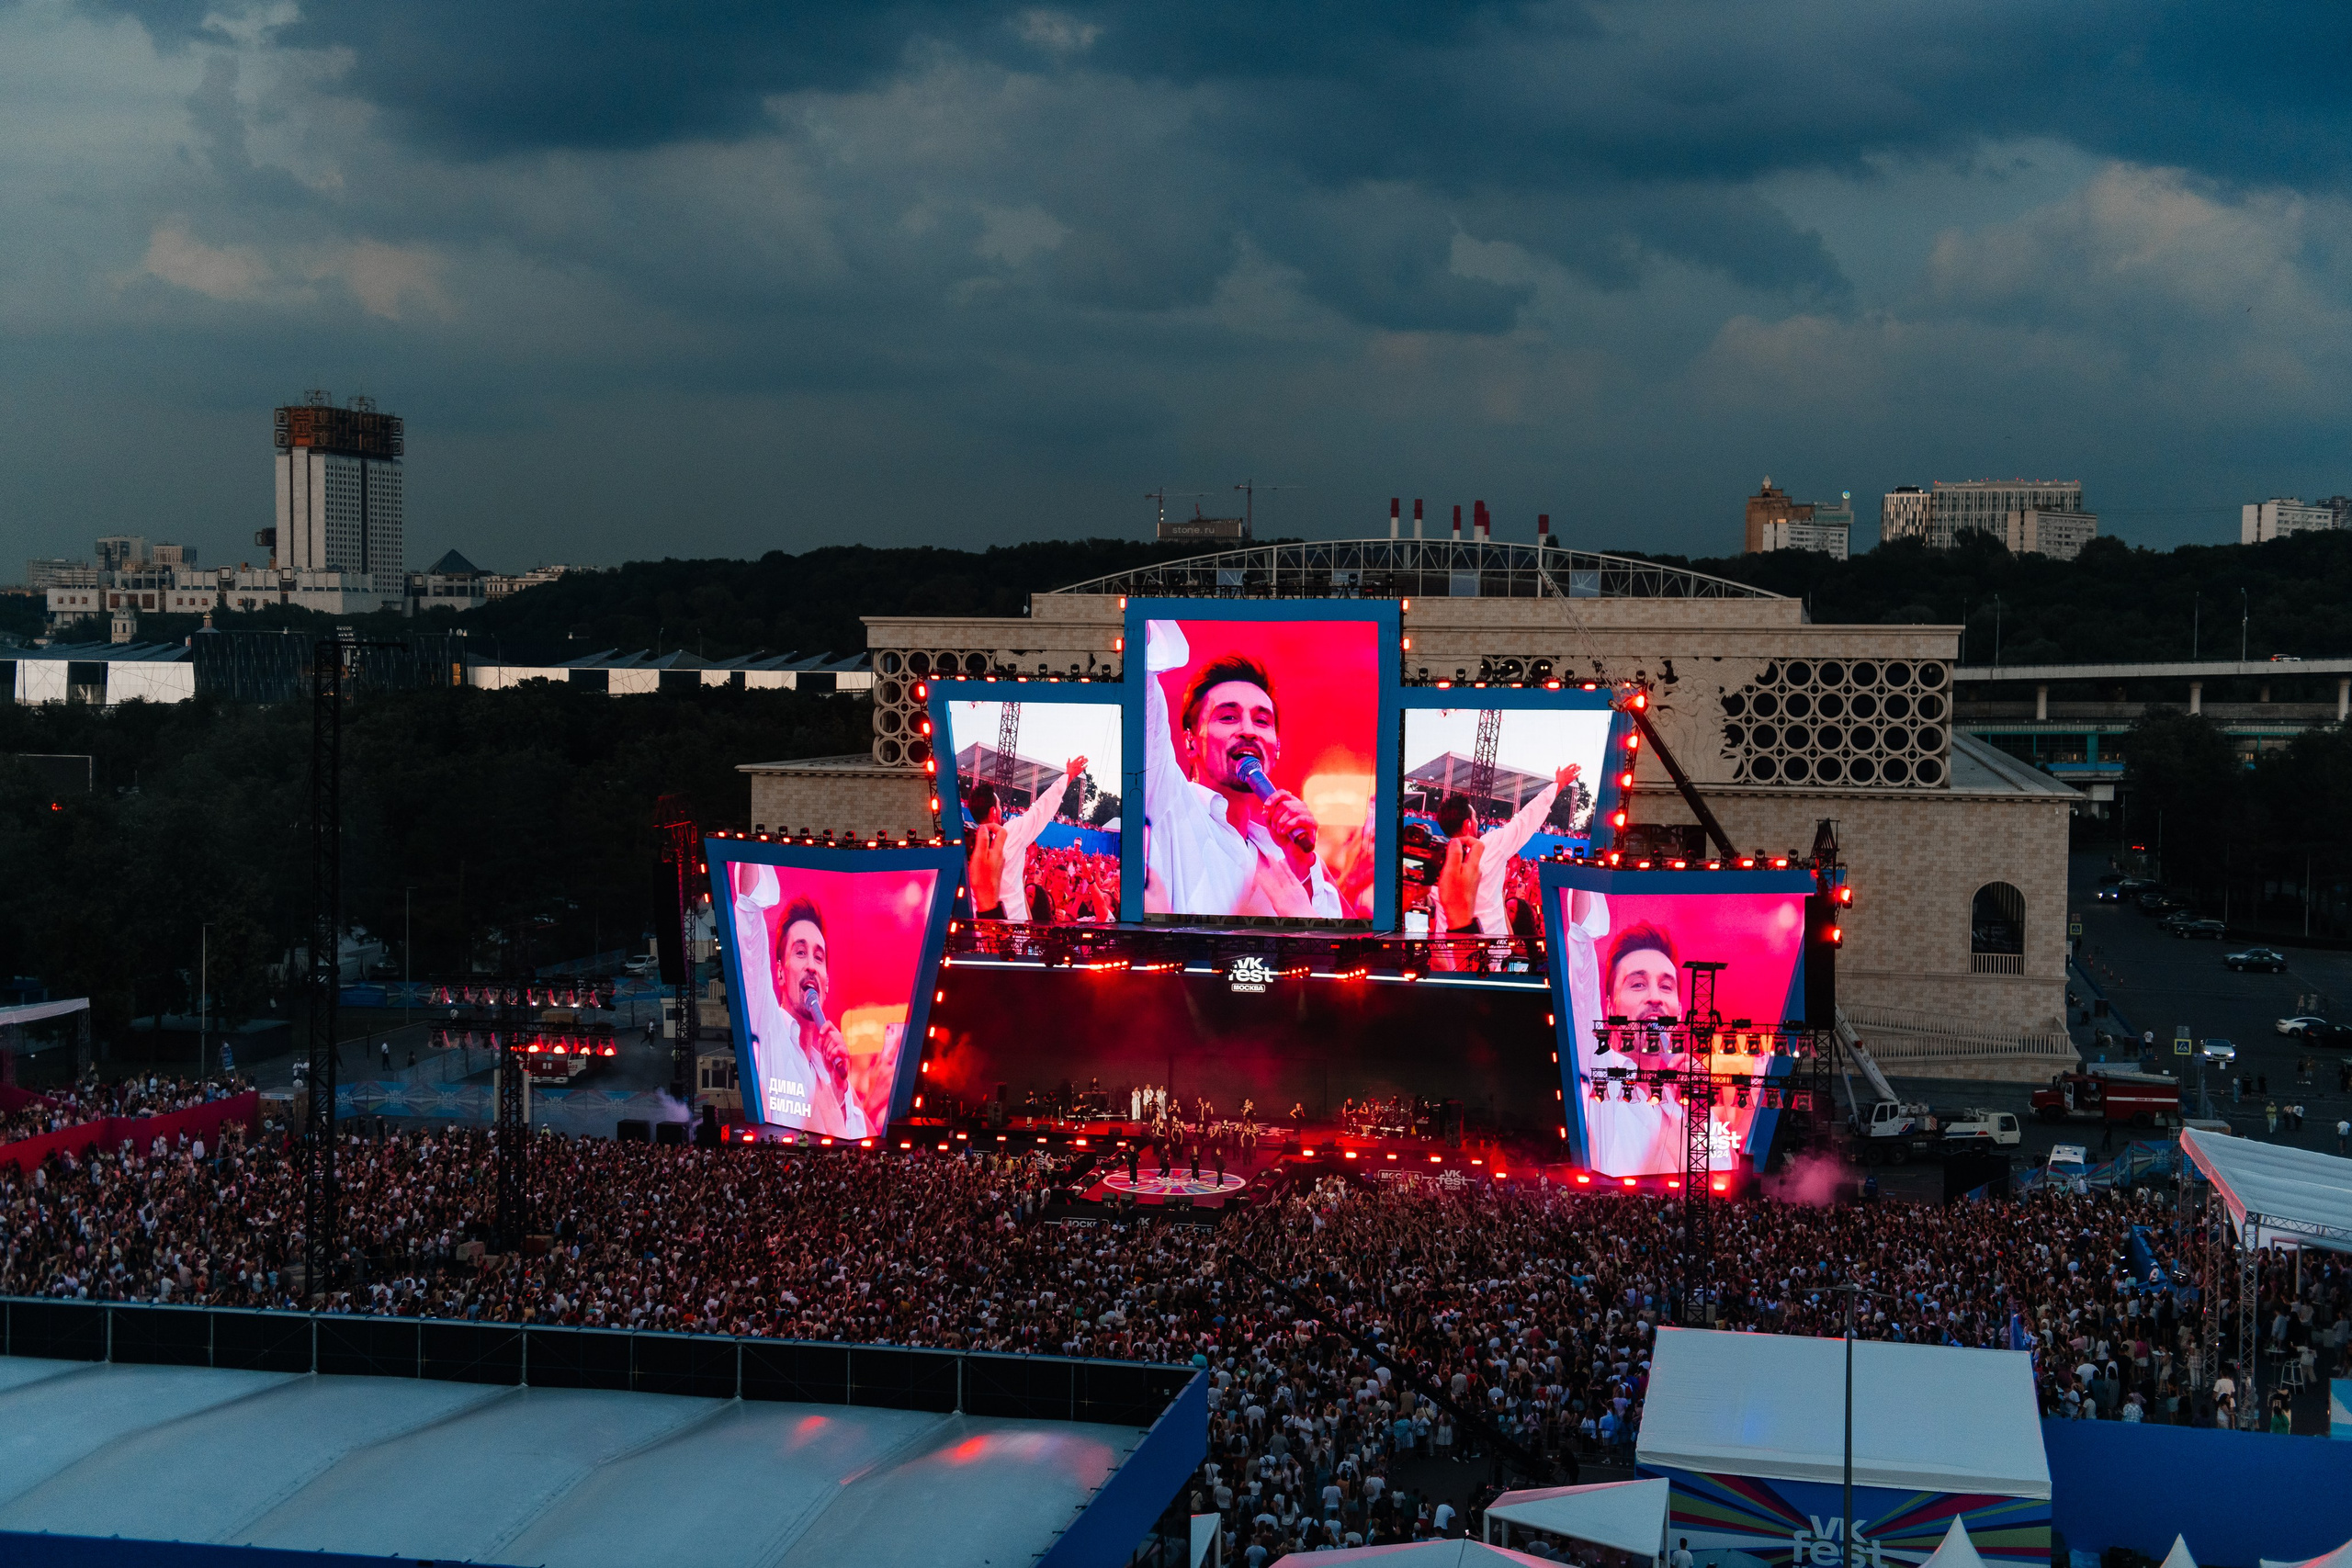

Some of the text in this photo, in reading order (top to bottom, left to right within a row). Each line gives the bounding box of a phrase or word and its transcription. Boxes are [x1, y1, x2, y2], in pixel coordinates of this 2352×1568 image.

[1172, 526, 1216, 535] stone.ru
[1237, 957, 1263, 970] VK
[768, 1077, 805, 1098] ДИМА
[769, 1096, 811, 1118] БИЛАН
[1703, 1122, 1730, 1135] VK
[1693, 1131, 1742, 1150] fest
[1381, 1172, 1420, 1180] МОСА
[1439, 1173, 1468, 1186] fest
[1443, 1168, 1462, 1178] VK
[1809, 1515, 1868, 1543] VK
[1793, 1529, 1889, 1568] fest
